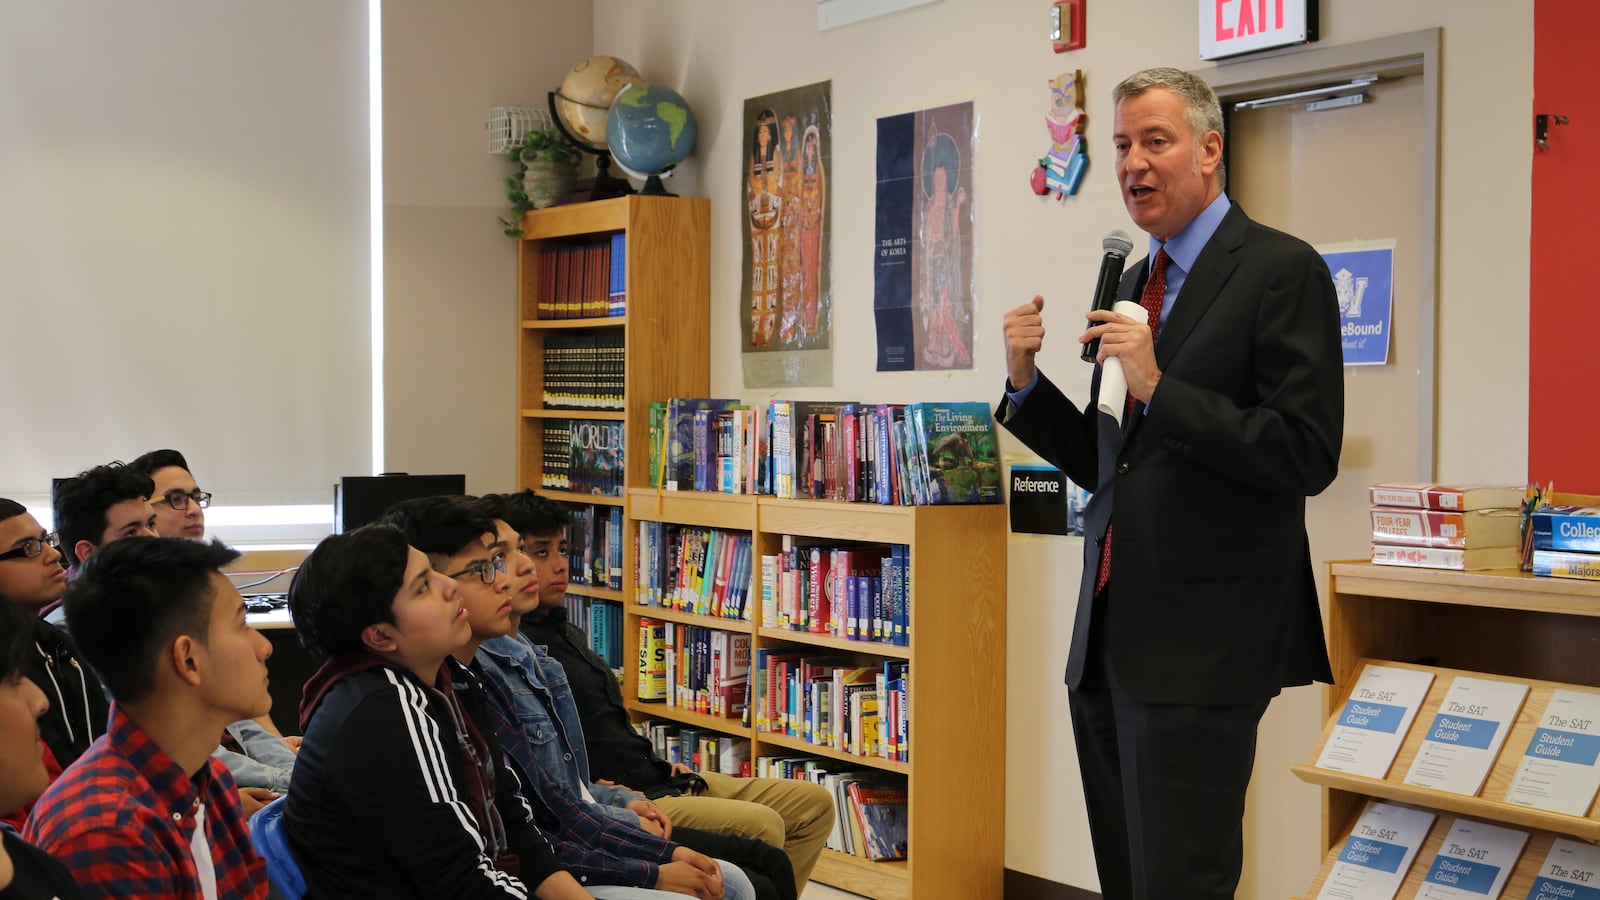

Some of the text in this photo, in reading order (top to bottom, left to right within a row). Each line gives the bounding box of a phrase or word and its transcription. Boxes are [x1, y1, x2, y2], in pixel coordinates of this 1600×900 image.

[881, 237, 906, 247] THE ARTS
[880, 247, 907, 256] OF KOREA
[1341, 320, 1382, 336] eBound
[934, 413, 974, 424] The Living
[934, 423, 989, 432] Environment
[569, 423, 609, 449] WORLD
[1013, 476, 1060, 493] Reference
[1376, 516, 1411, 528] FOUR-YEAR
[1377, 526, 1408, 536] COLLEGES
[1560, 521, 1600, 541] Colleg
[1568, 565, 1600, 578] Majors
[810, 564, 818, 617] Webster's
[702, 642, 708, 655] AP
[640, 649, 648, 677] SAT
[1359, 688, 1397, 702] The SAT
[1350, 703, 1381, 717] Student
[1447, 701, 1488, 716] The SAT
[1346, 714, 1369, 727] Guide
[1439, 718, 1472, 732] Student
[1548, 715, 1592, 731] The SAT
[1434, 729, 1460, 741] Guide
[1539, 732, 1575, 747] Student
[1534, 743, 1562, 757] Guide
[1360, 824, 1398, 840] The SAT
[1351, 840, 1382, 855] Student
[1448, 843, 1489, 861] The SAT
[1346, 850, 1370, 864] Guide
[1439, 859, 1472, 875] Student
[1549, 863, 1594, 883] The SAT
[1434, 870, 1460, 884] Guide
[1540, 881, 1576, 899] Student
